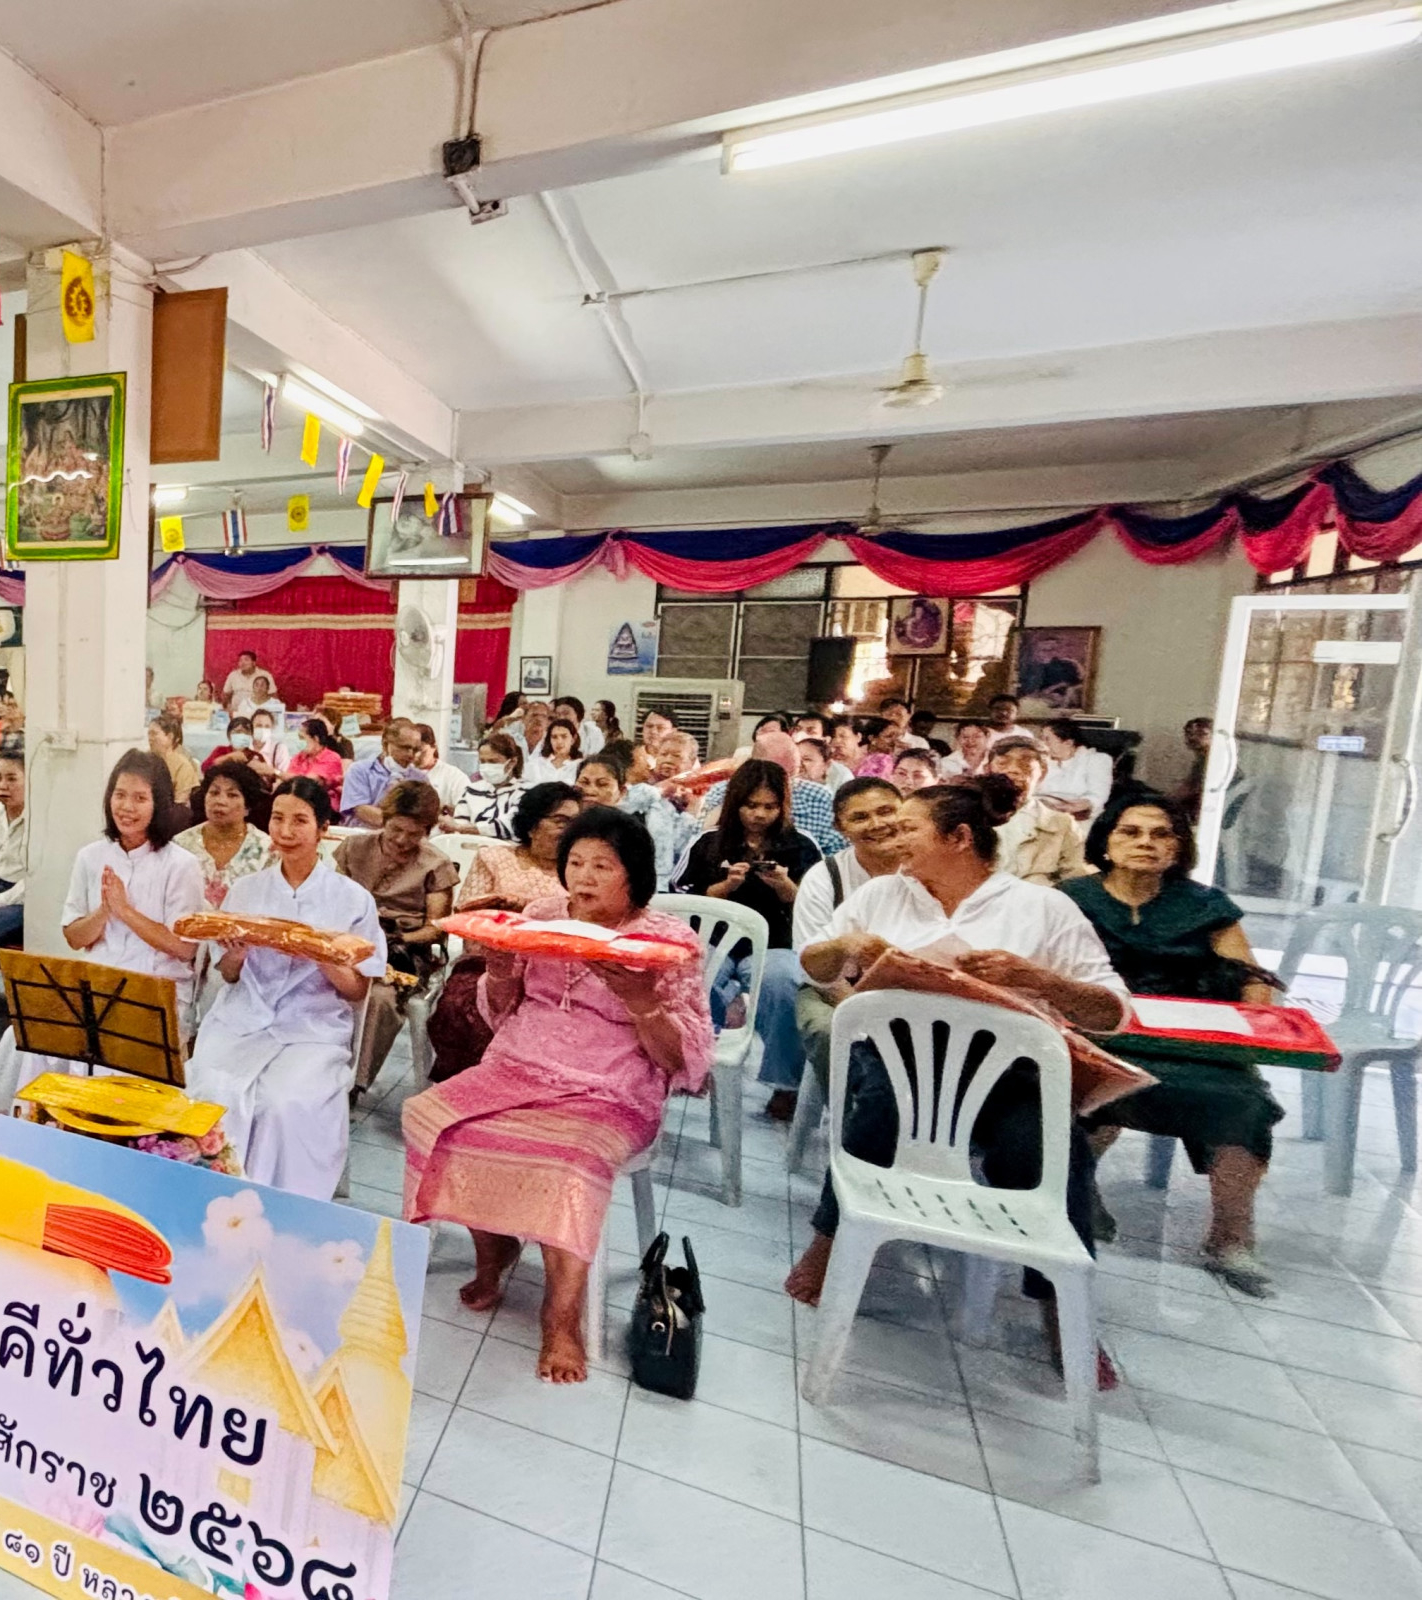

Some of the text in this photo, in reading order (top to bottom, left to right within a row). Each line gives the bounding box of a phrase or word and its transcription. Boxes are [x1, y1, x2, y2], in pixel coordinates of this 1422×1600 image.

[5, 1532, 40, 1563] ๘๑
[53, 1544, 72, 1576] ปี
[139, 1473, 357, 1600] ๒๕๖๘
